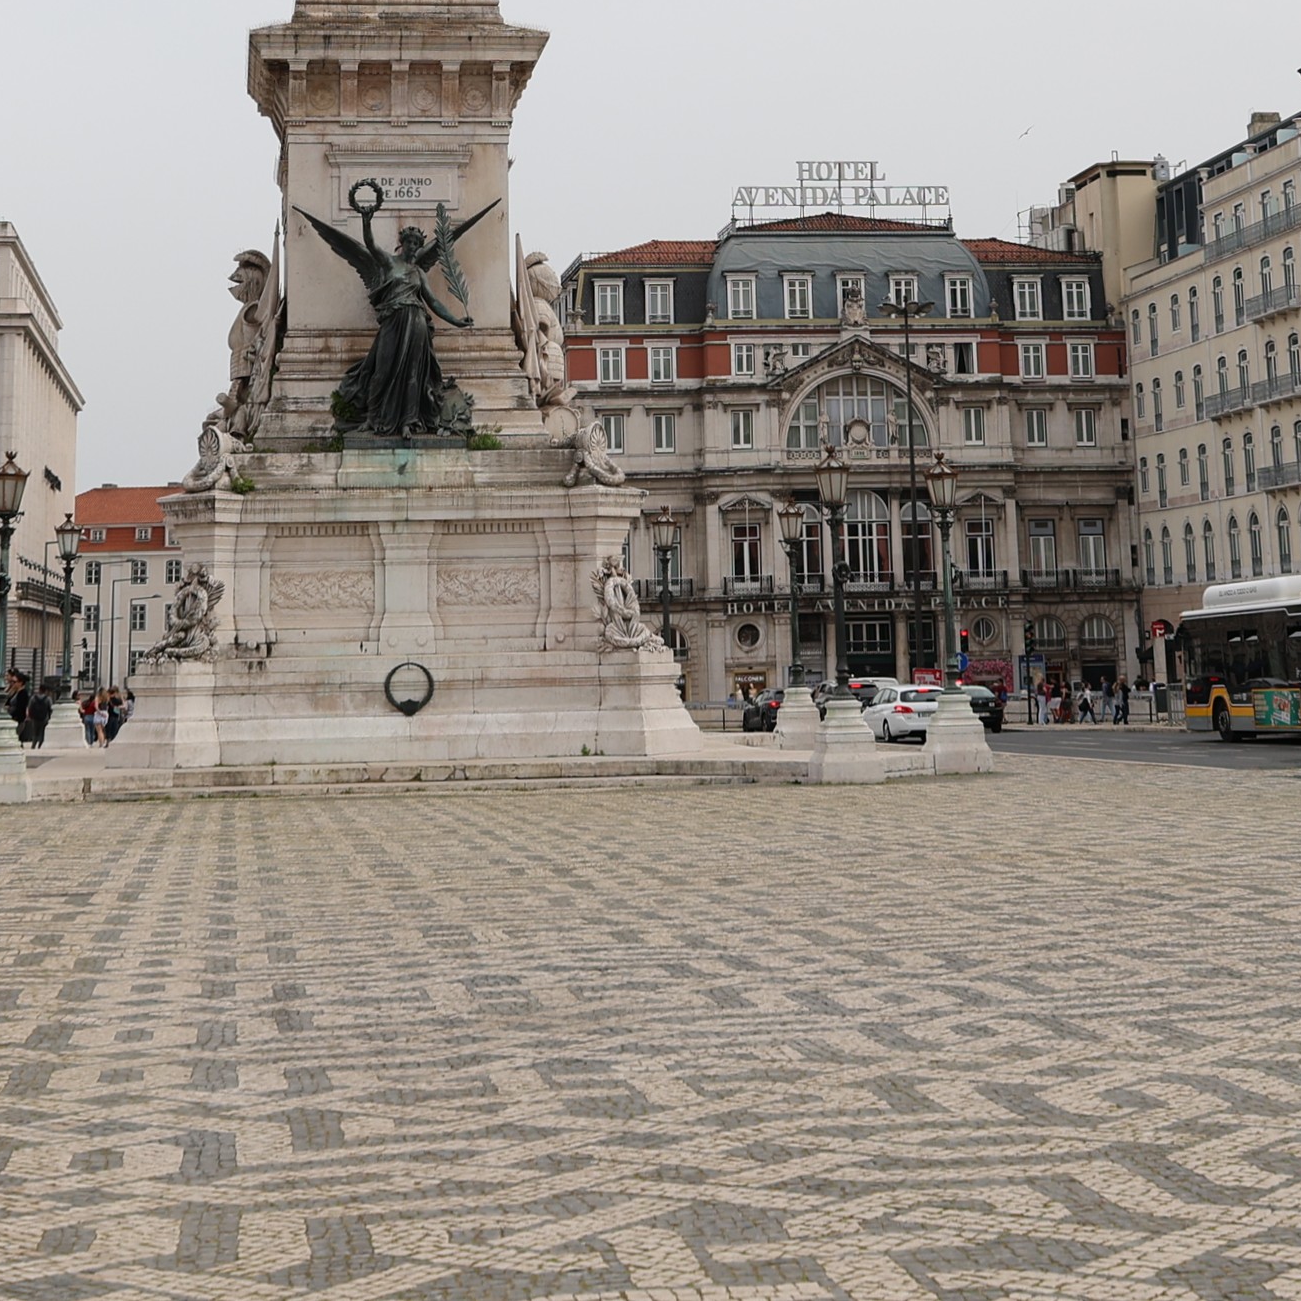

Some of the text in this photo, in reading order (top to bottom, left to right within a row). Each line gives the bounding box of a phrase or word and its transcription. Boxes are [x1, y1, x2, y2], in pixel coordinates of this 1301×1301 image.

[796, 161, 886, 181] HOTEL
[381, 178, 432, 187] DE JUNHO
[395, 186, 421, 198] 1665
[731, 186, 949, 207] AVENIDA PALACE
[930, 596, 1009, 610] PLACE
